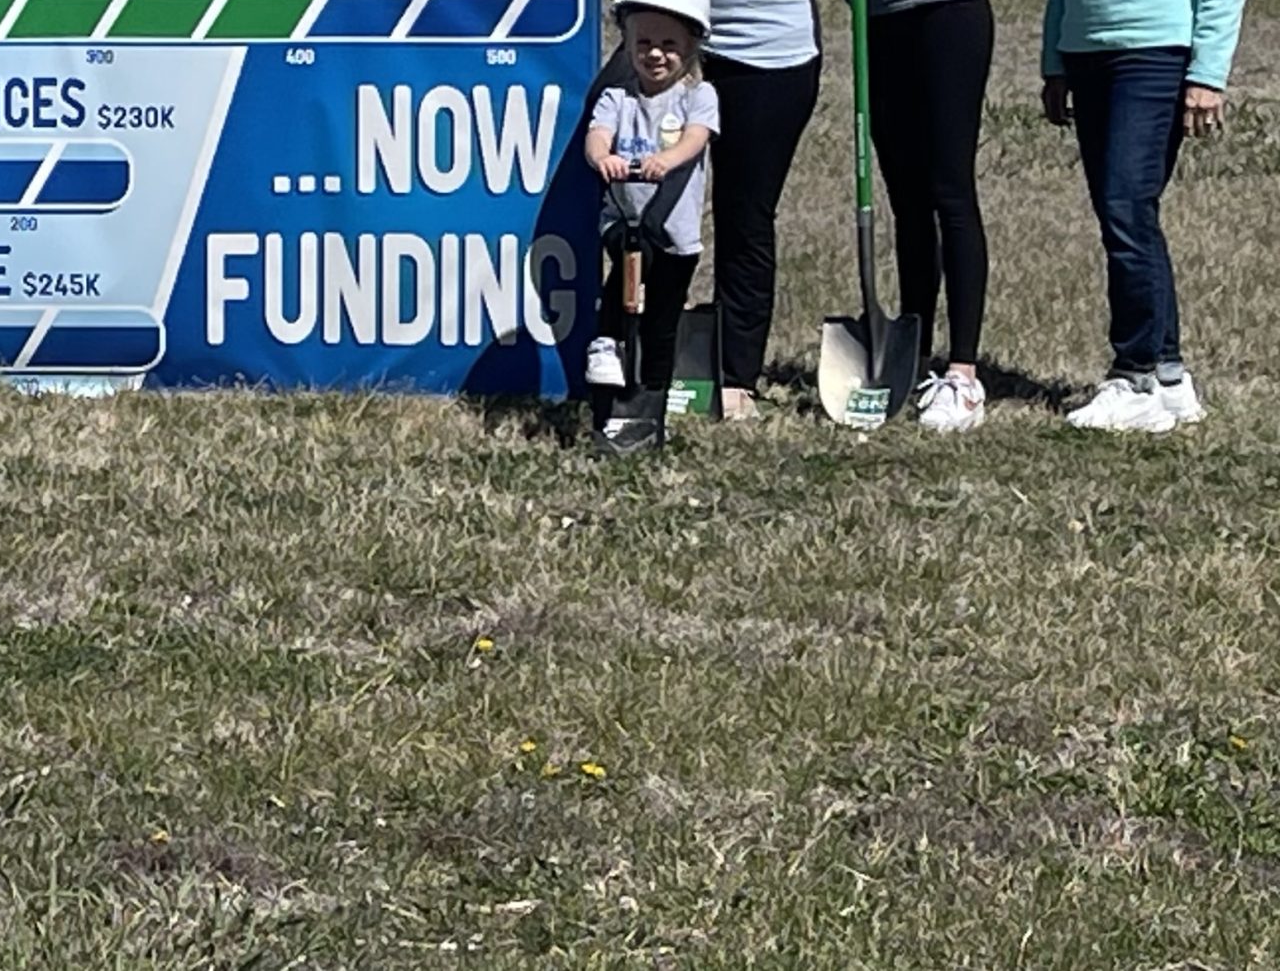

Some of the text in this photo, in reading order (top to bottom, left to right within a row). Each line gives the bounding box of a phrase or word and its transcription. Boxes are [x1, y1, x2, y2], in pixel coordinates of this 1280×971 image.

[86, 49, 115, 65] 300
[286, 48, 315, 65] 400
[486, 48, 517, 65] 500
[97, 104, 175, 131] $230K
[10, 216, 38, 232] 200
[22, 273, 100, 299] $245K
[207, 232, 577, 346] FUNDING
